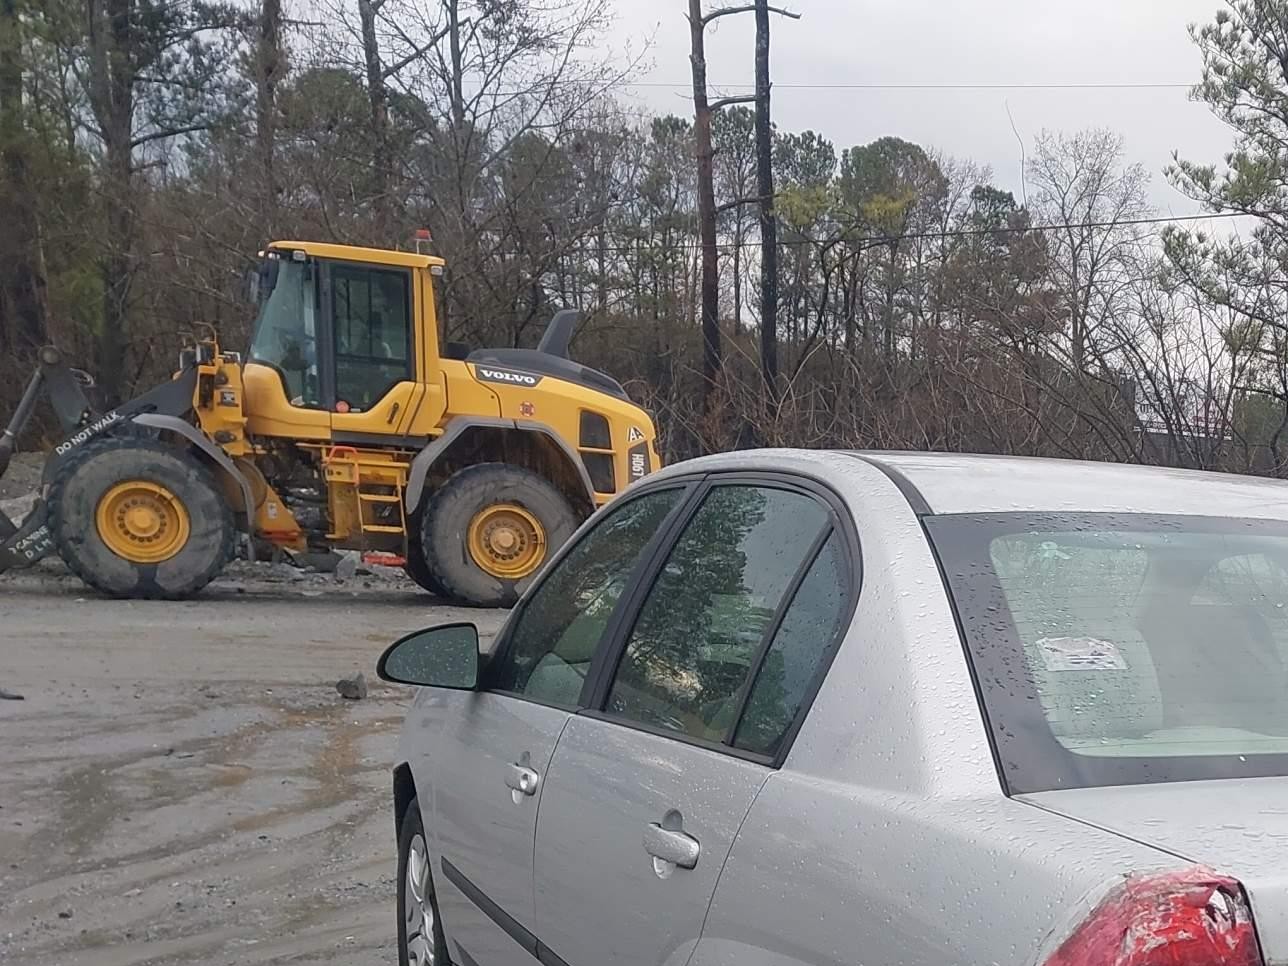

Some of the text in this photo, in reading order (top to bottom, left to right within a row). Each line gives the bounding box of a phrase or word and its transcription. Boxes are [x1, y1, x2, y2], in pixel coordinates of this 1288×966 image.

[480, 370, 535, 384] VOLVO
[55, 411, 121, 455] DO NOT WALK
[631, 453, 645, 476] L90H
